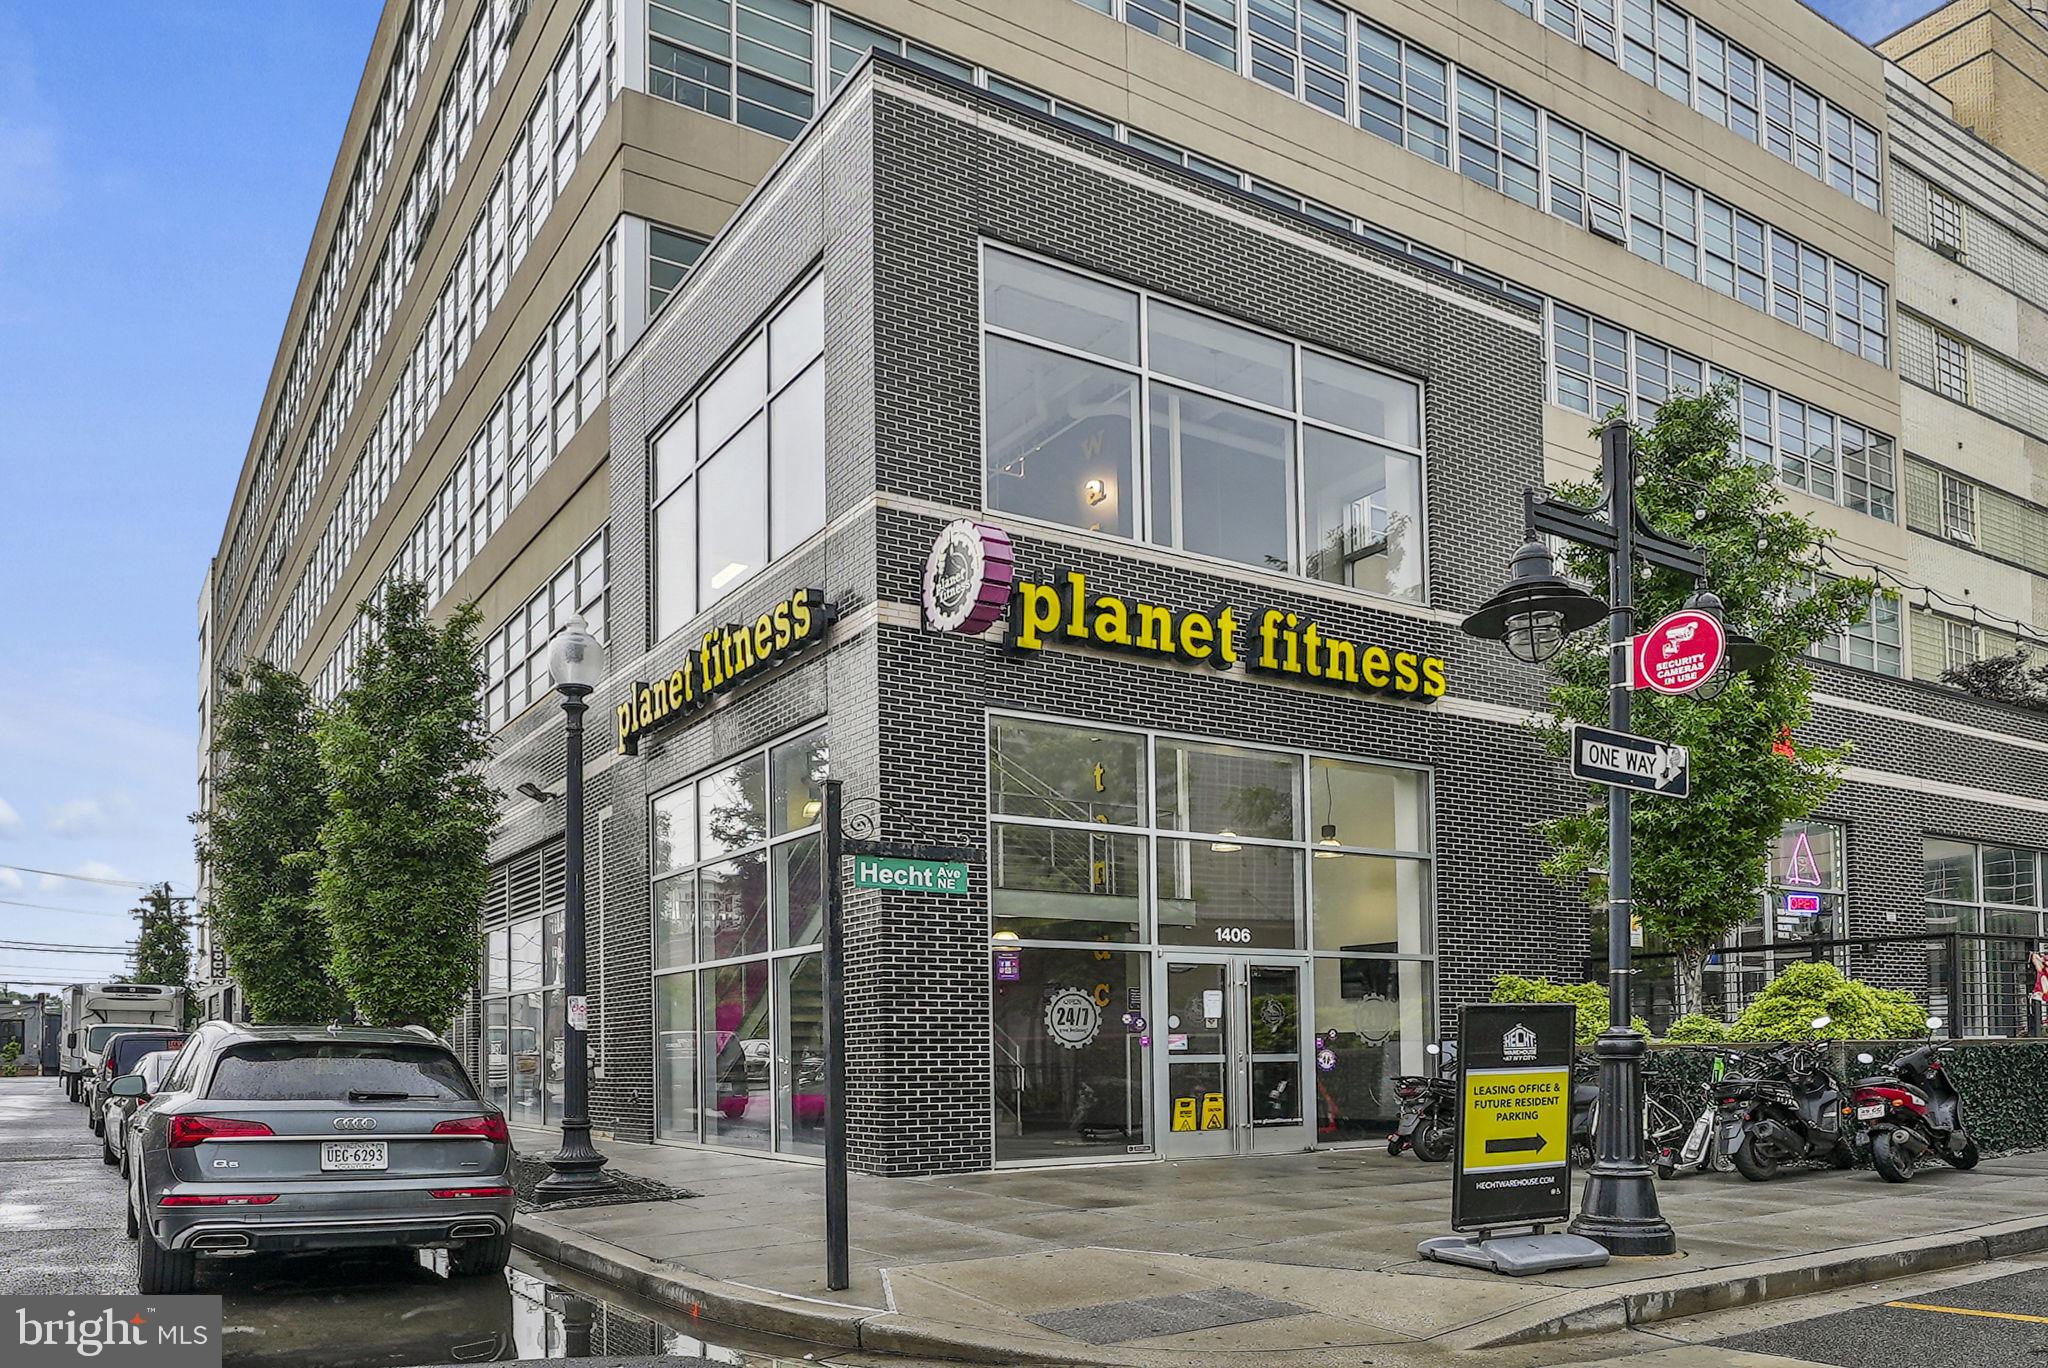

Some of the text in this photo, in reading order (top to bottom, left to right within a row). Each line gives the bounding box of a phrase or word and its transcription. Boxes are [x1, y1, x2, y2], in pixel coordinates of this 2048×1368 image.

[935, 568, 966, 597] planet
[1016, 570, 1447, 700] planet fitness
[1656, 653, 1706, 671] SECURITY
[616, 588, 812, 755] planet fitness
[1657, 662, 1705, 679] CAMERAS
[1664, 672, 1698, 685] IN USE
[1589, 744, 1657, 775] ONE WAY
[860, 861, 961, 887] Hecht Ave
[938, 879, 956, 890] NE
[1791, 898, 1816, 910] OPEN
[1214, 927, 1251, 943] 1406
[1057, 1007, 1089, 1026] 24/7
[1504, 1029, 1536, 1047] HECHT
[1473, 1083, 1560, 1096] LEASING OFFICE &
[1474, 1096, 1560, 1109] FUTURE RESIDENT
[1496, 1111, 1539, 1122] PARKING
[213, 1159, 239, 1168] Q5
[327, 1149, 383, 1162] UEG-6293
[1476, 1176, 1555, 1190] HECHTWAREHOUSE.COM
